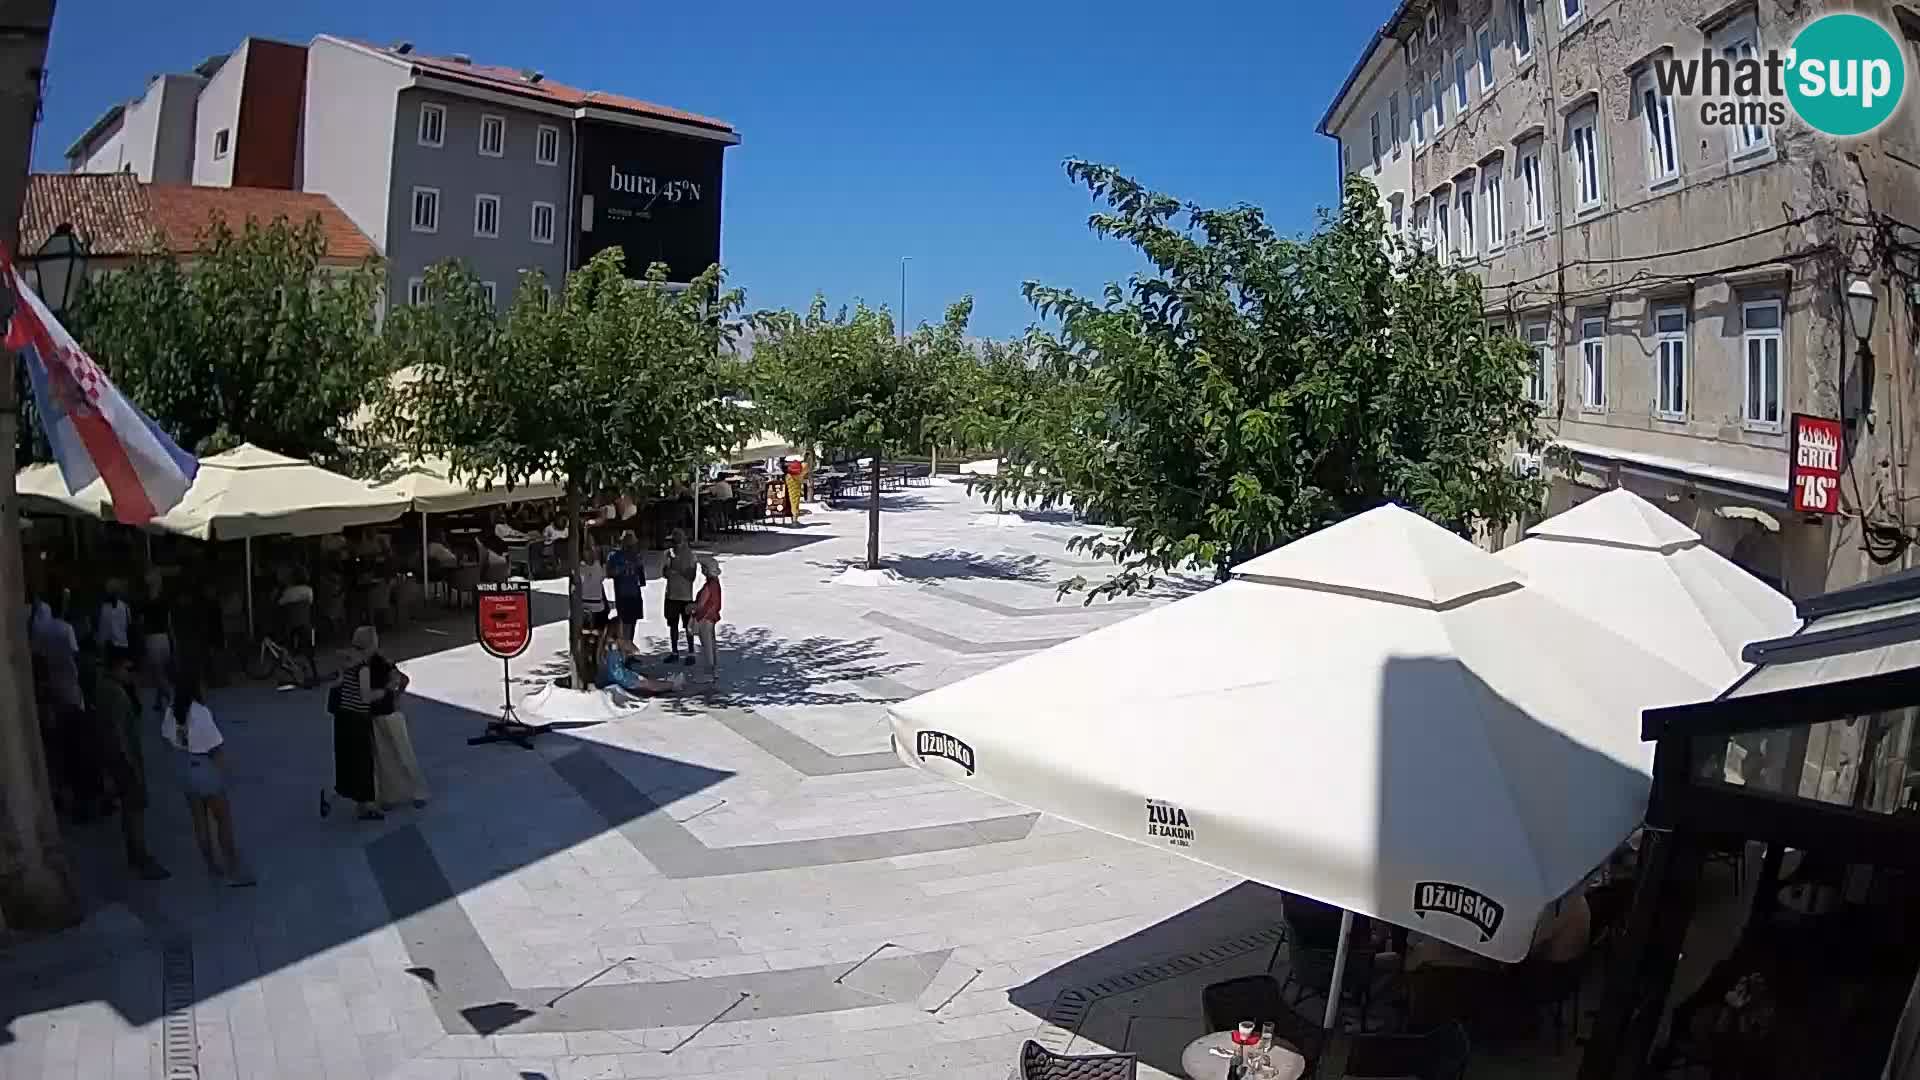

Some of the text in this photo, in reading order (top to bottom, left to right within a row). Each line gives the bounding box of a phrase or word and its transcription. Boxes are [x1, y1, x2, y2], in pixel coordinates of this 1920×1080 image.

[610, 165, 656, 196] bura
[1797, 446, 1838, 471] GRILL
[476, 583, 498, 591] WINE
[500, 582, 519, 591] BAR
[920, 732, 971, 766] Ožujsko
[1146, 798, 1189, 827] ŽUJA
[1148, 824, 1157, 835] JE
[1422, 884, 1496, 929] Ožujsko
